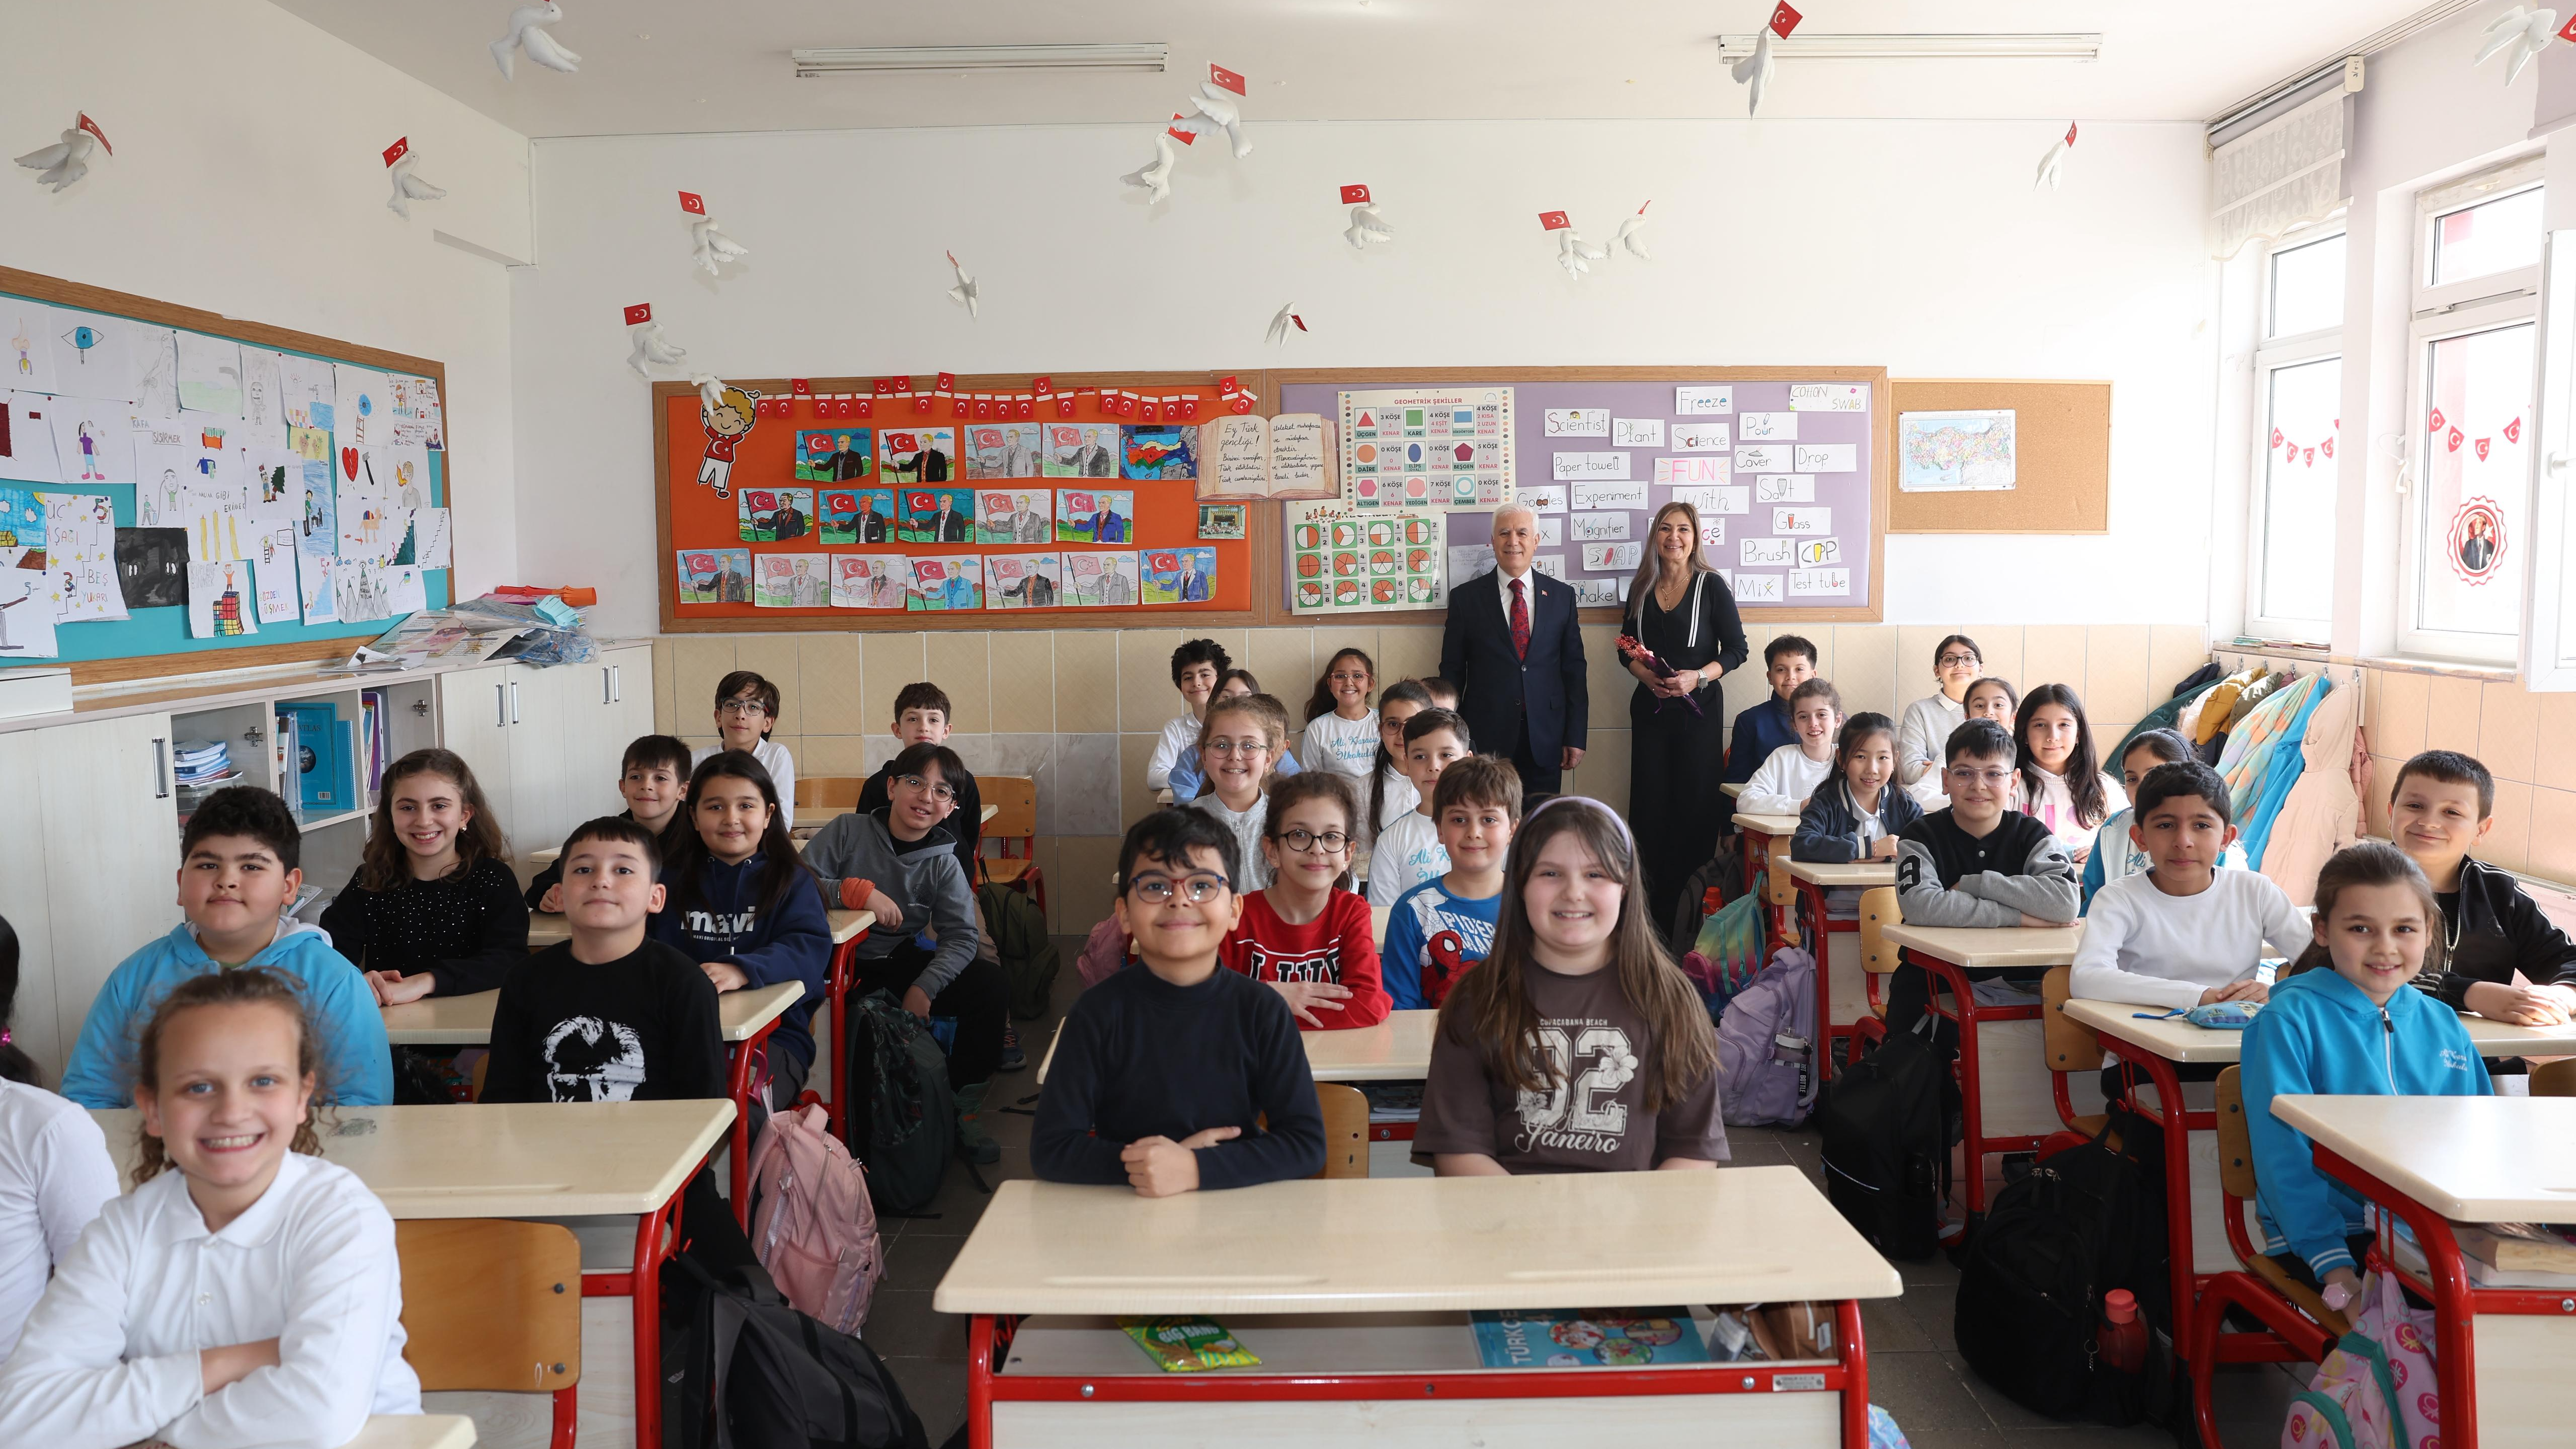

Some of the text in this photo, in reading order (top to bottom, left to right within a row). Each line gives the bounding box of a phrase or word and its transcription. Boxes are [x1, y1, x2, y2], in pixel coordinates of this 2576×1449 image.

[1681, 391, 1727, 414] Freeze
[1832, 398, 1861, 410] SWAB
[132, 419, 149, 428] KAFA
[1225, 422, 1259, 438] Ey Türk
[1548, 411, 1606, 433] Scientist
[1747, 417, 1774, 437] Pour
[1618, 422, 1656, 444] Plant
[1674, 427, 1726, 449] Science
[1555, 454, 1619, 476] Paper towel
[1735, 450, 1772, 467] Cover
[1799, 448, 1828, 466] Drop
[1672, 459, 1715, 482] FUN
[1575, 485, 1642, 506] Experiment
[1760, 478, 1795, 500] Salt
[46, 500, 65, 521] ÜÇ
[1775, 511, 1810, 529] Glass
[1574, 517, 1624, 539] Magnifier
[1588, 546, 1638, 566] SOAP
[1745, 540, 1790, 562] Brush
[1802, 540, 1837, 563] CUP
[89, 569, 108, 586] BEŞ
[1791, 572, 1845, 589] Test tube
[25, 582, 31, 595] 5
[82, 591, 108, 603] YUKARI
[1738, 579, 1774, 597] Mix
[1331, 737, 1344, 747] Ali
[1409, 848, 1431, 865] Ali
[2127, 852, 2145, 867] Ali
[1898, 854, 1922, 896] 9
[681, 906, 755, 933] mavi
[1517, 1027, 1631, 1136] 92
[1515, 1113, 1620, 1153] Janeiro
[1159, 1327, 1185, 1343] BIG
